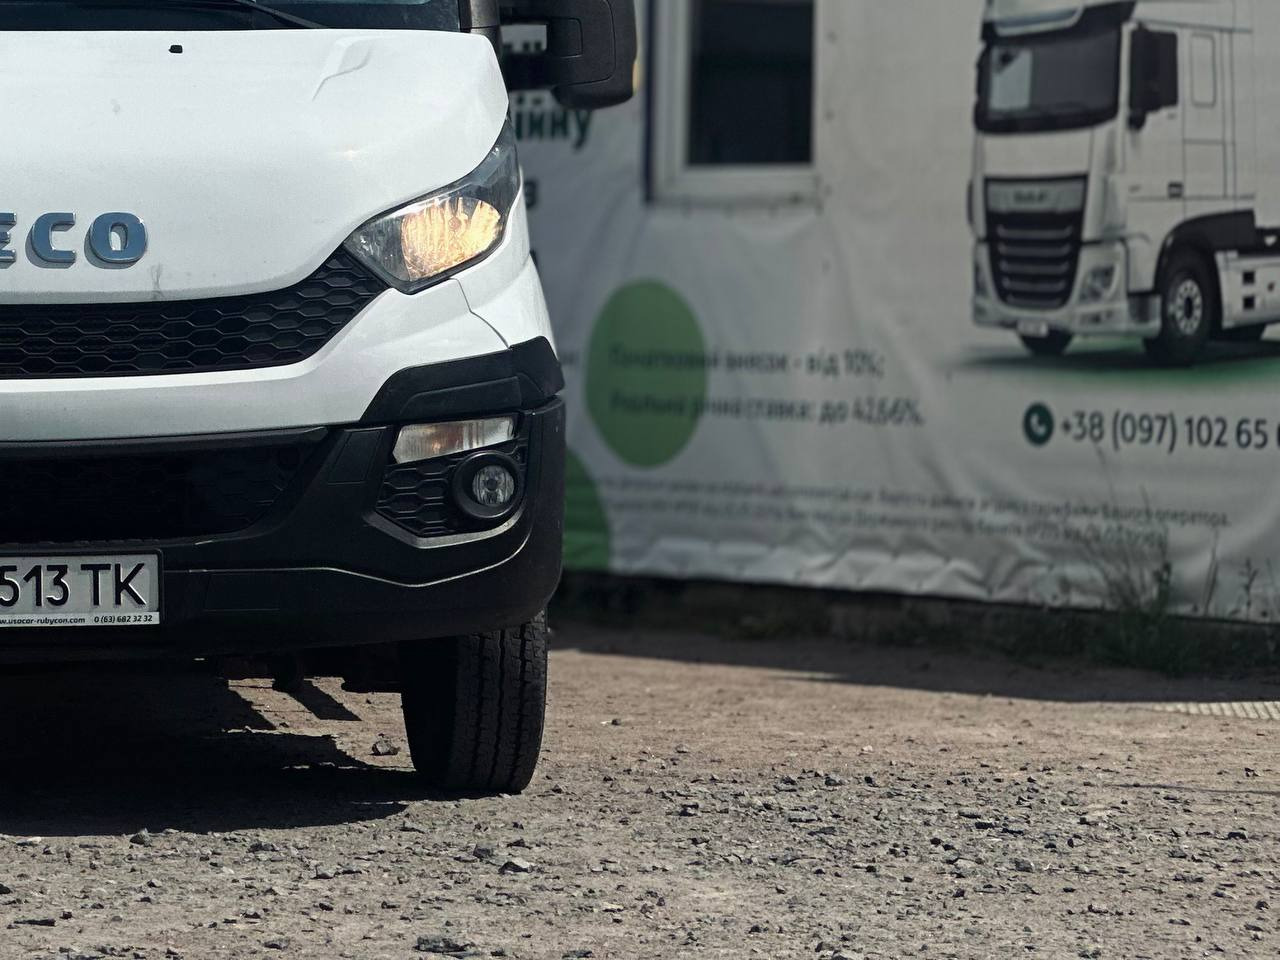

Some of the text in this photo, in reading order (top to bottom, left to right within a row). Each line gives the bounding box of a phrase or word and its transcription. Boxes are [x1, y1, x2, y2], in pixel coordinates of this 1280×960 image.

[1061, 410, 1105, 442] +38
[1112, 409, 1177, 454] (097)
[1185, 415, 1228, 448] 102
[1235, 418, 1269, 450] 65
[80, 563, 147, 607] TK
[100, 615, 116, 624] (63)
[132, 615, 142, 623] 32
[143, 614, 153, 622] 32
